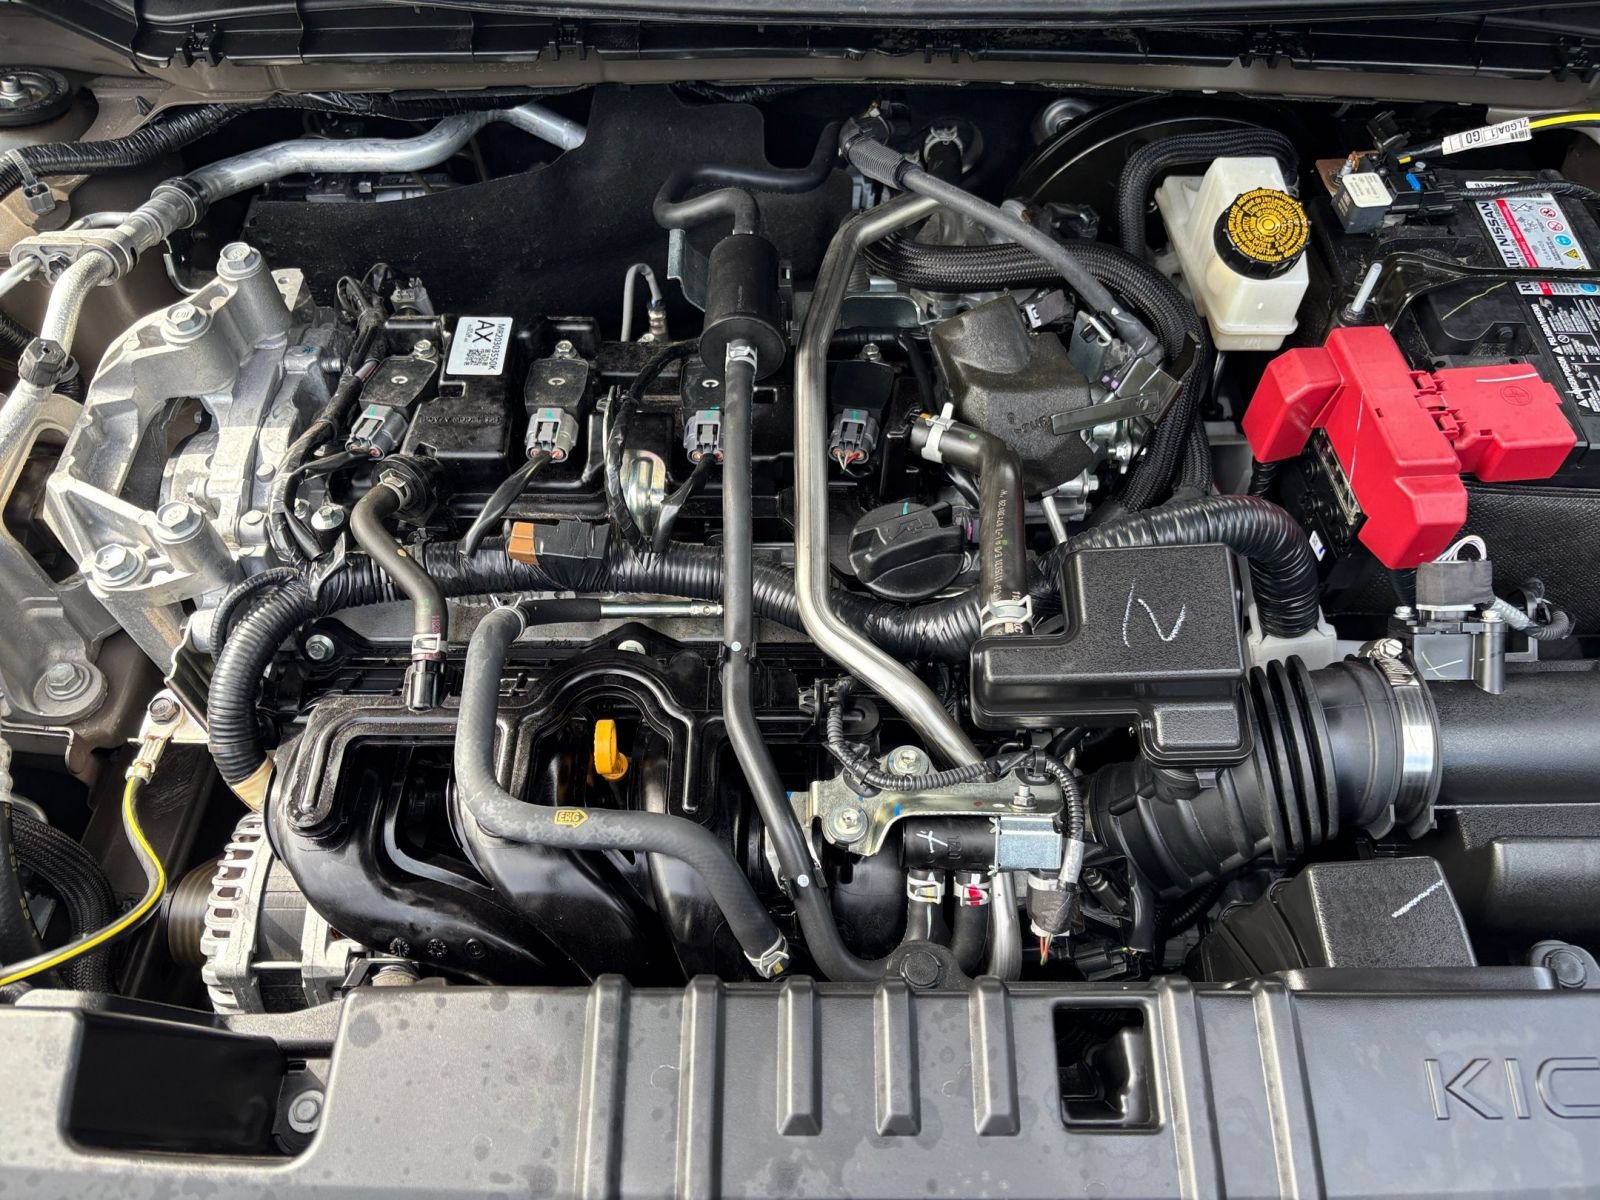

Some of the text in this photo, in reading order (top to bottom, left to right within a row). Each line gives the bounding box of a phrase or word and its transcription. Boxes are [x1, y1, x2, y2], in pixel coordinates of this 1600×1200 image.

[1479, 201, 1510, 246] NISSAN
[472, 319, 496, 343] AX
[557, 811, 580, 827] ENG
